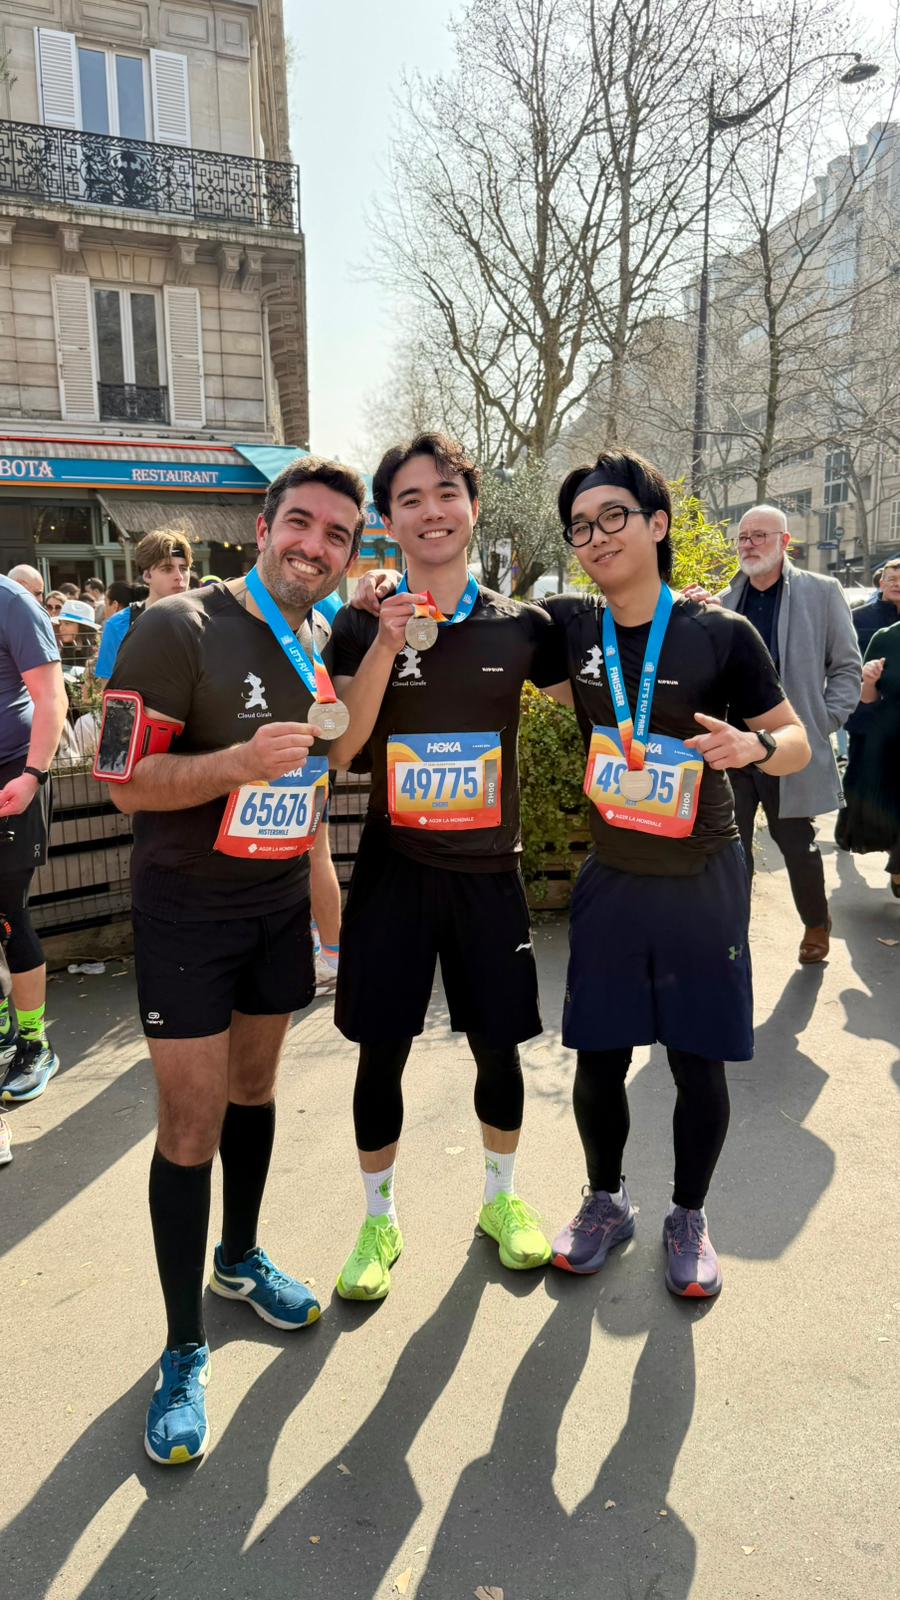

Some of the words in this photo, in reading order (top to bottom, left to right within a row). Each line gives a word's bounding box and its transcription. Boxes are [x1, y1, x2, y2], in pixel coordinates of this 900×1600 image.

[131, 468, 219, 484] RESTAURANT
[609, 666, 625, 707] FINISHER
[642, 678, 651, 699] LET'S
[640, 699, 648, 713] FLY
[637, 714, 646, 737] PARIS
[426, 742, 462, 754] HOKA
[401, 767, 478, 800] 49775
[487, 782, 495, 804] 2H00
[240, 791, 308, 827] 65676
[681, 792, 691, 816] 2H00
